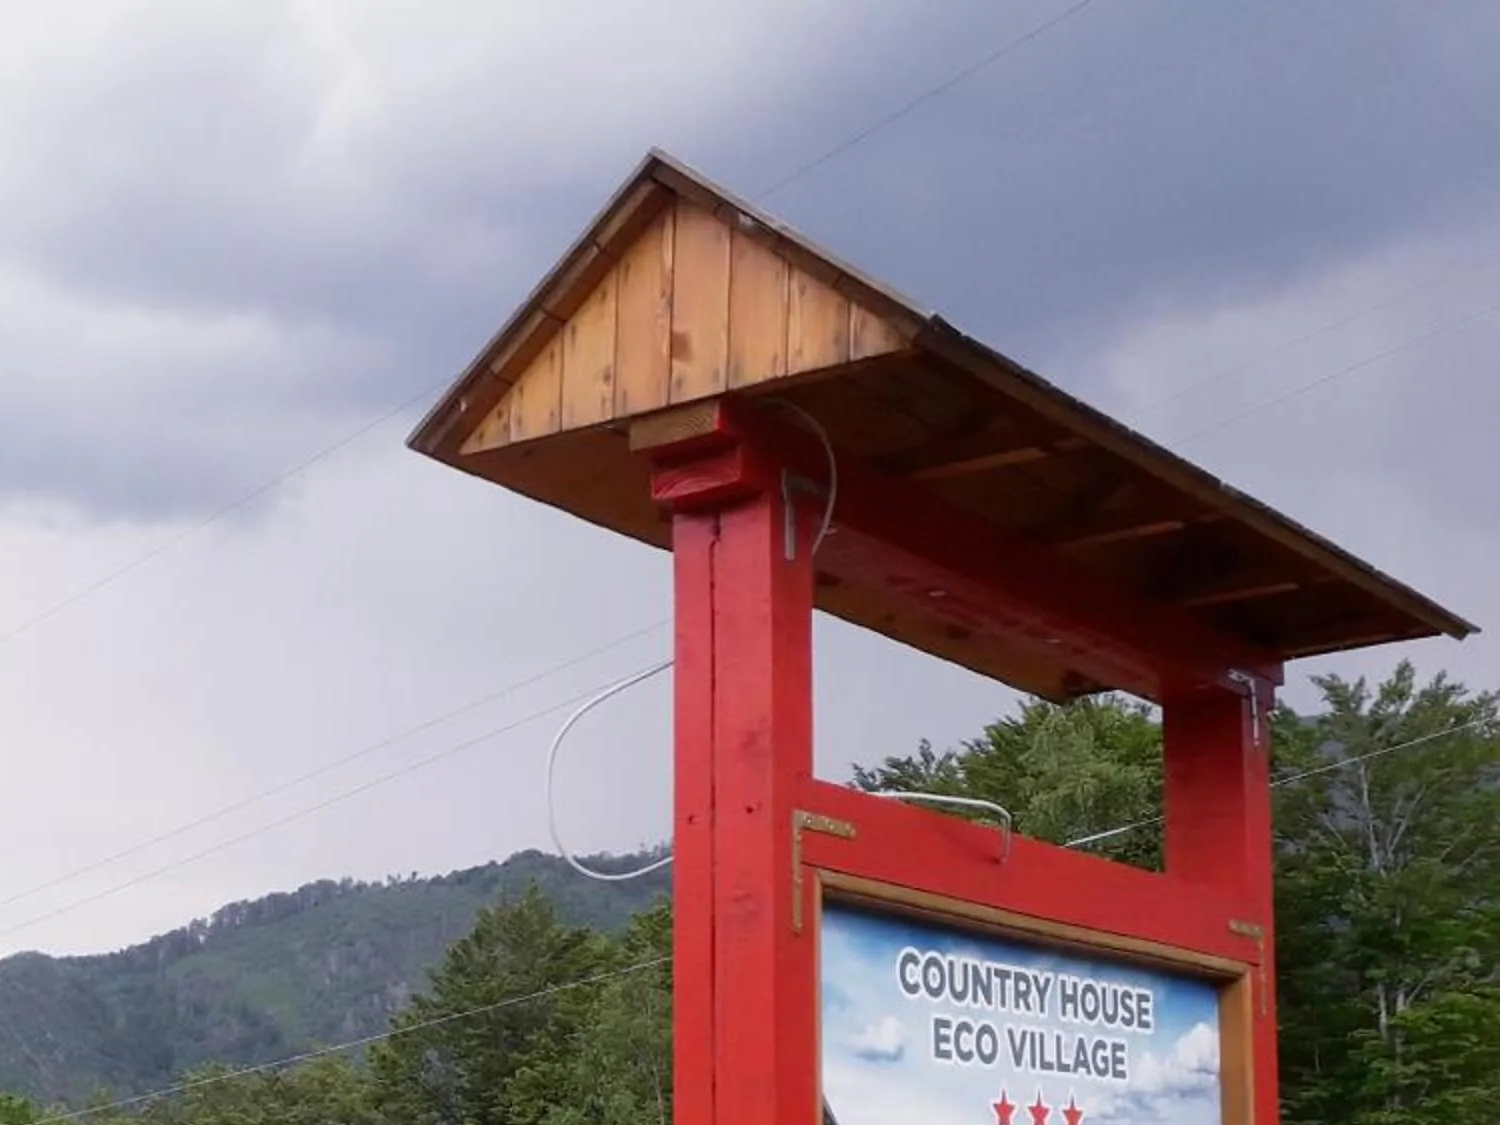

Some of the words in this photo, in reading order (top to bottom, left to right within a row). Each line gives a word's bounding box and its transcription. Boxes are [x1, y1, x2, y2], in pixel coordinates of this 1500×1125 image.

[900, 952, 1051, 1011] COUNTRY
[1060, 981, 1151, 1028] HOUSE
[933, 1018, 998, 1062] ECO
[1008, 1029, 1127, 1078] VILLAGE
